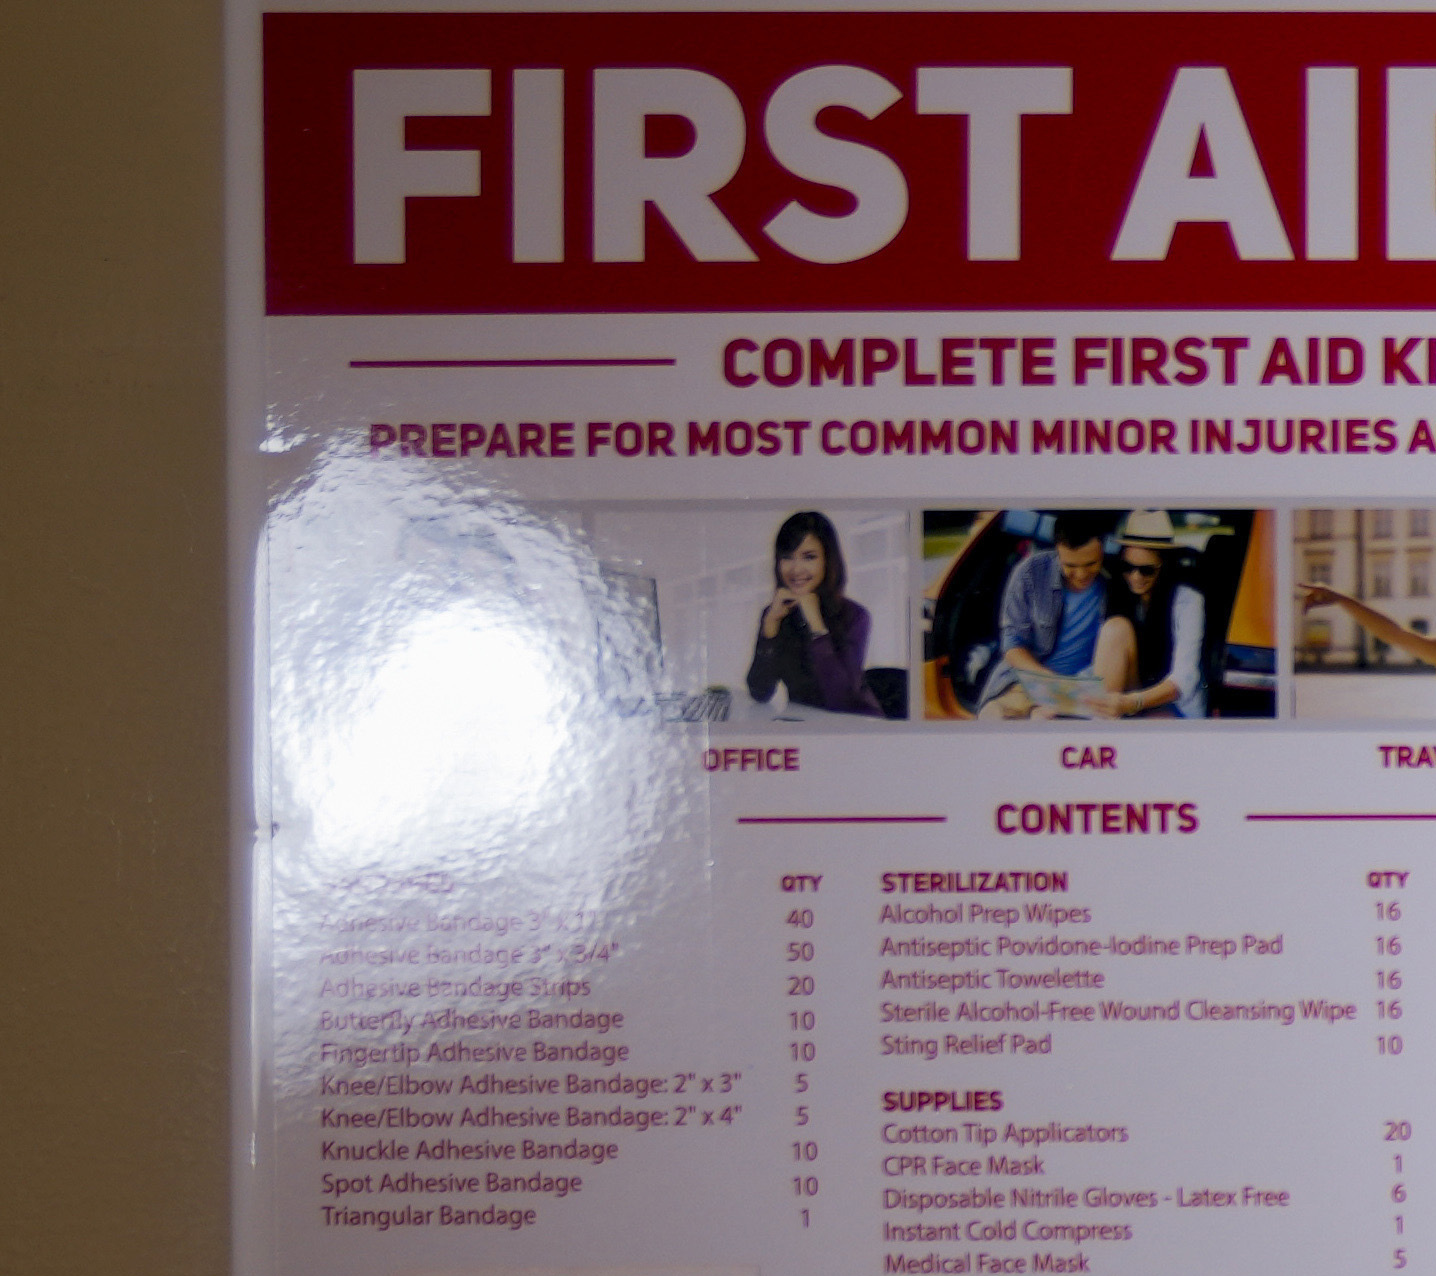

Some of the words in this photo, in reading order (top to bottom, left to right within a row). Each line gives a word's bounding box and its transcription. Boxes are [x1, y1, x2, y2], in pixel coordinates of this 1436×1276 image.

[352, 64, 1074, 265] FIRST
[722, 337, 1056, 388] COMPLETE
[1073, 336, 1251, 387] FIRST
[1259, 337, 1365, 386] AID
[370, 421, 575, 459] PREPARE
[587, 421, 675, 457] FOR
[687, 420, 812, 457] MOST
[820, 419, 1019, 456] COMMON
[1031, 418, 1178, 455] MINOR
[1189, 418, 1399, 455] INJURIES
[703, 746, 800, 773] OFFICE
[1060, 745, 1117, 770] CAR
[994, 802, 1199, 836] CONTENTS
[881, 871, 1068, 894] STERILIZATION
[878, 902, 964, 925] Alcohol
[967, 902, 1020, 929] Prep
[1023, 902, 1092, 929] Wipes
[1375, 900, 1402, 922] 16
[882, 1090, 1004, 1113] SUPPLIES
[320, 1204, 435, 1232] Triangular
[438, 1203, 537, 1231] Bandage
[800, 1208, 810, 1229] 1
